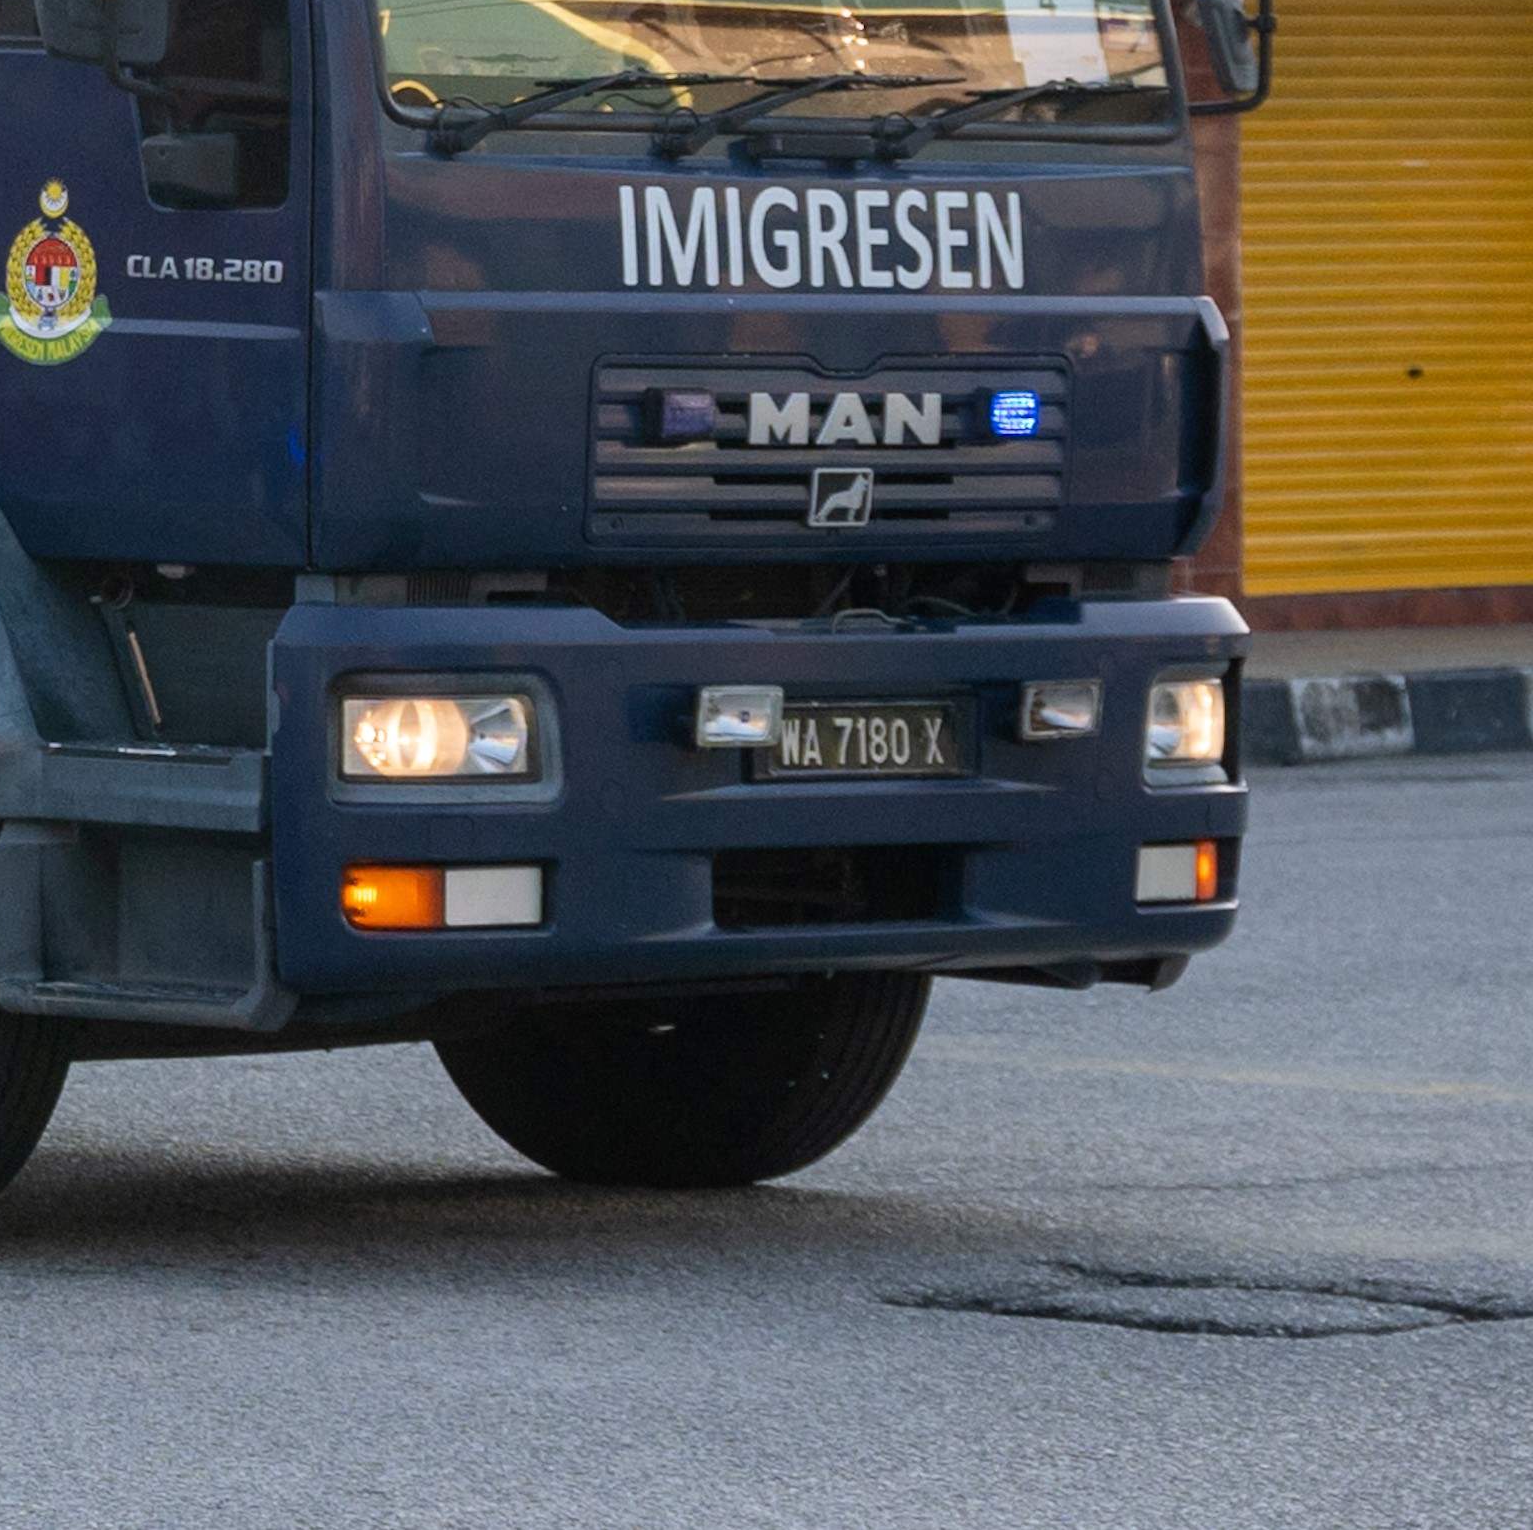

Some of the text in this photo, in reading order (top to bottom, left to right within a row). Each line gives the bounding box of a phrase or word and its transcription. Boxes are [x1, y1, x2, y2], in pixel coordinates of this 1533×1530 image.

[618, 184, 1025, 290] IMIGRESEN
[126, 254, 284, 284] CLA 18.280
[747, 392, 942, 446] MAN
[781, 717, 945, 766] WA 7180 X
